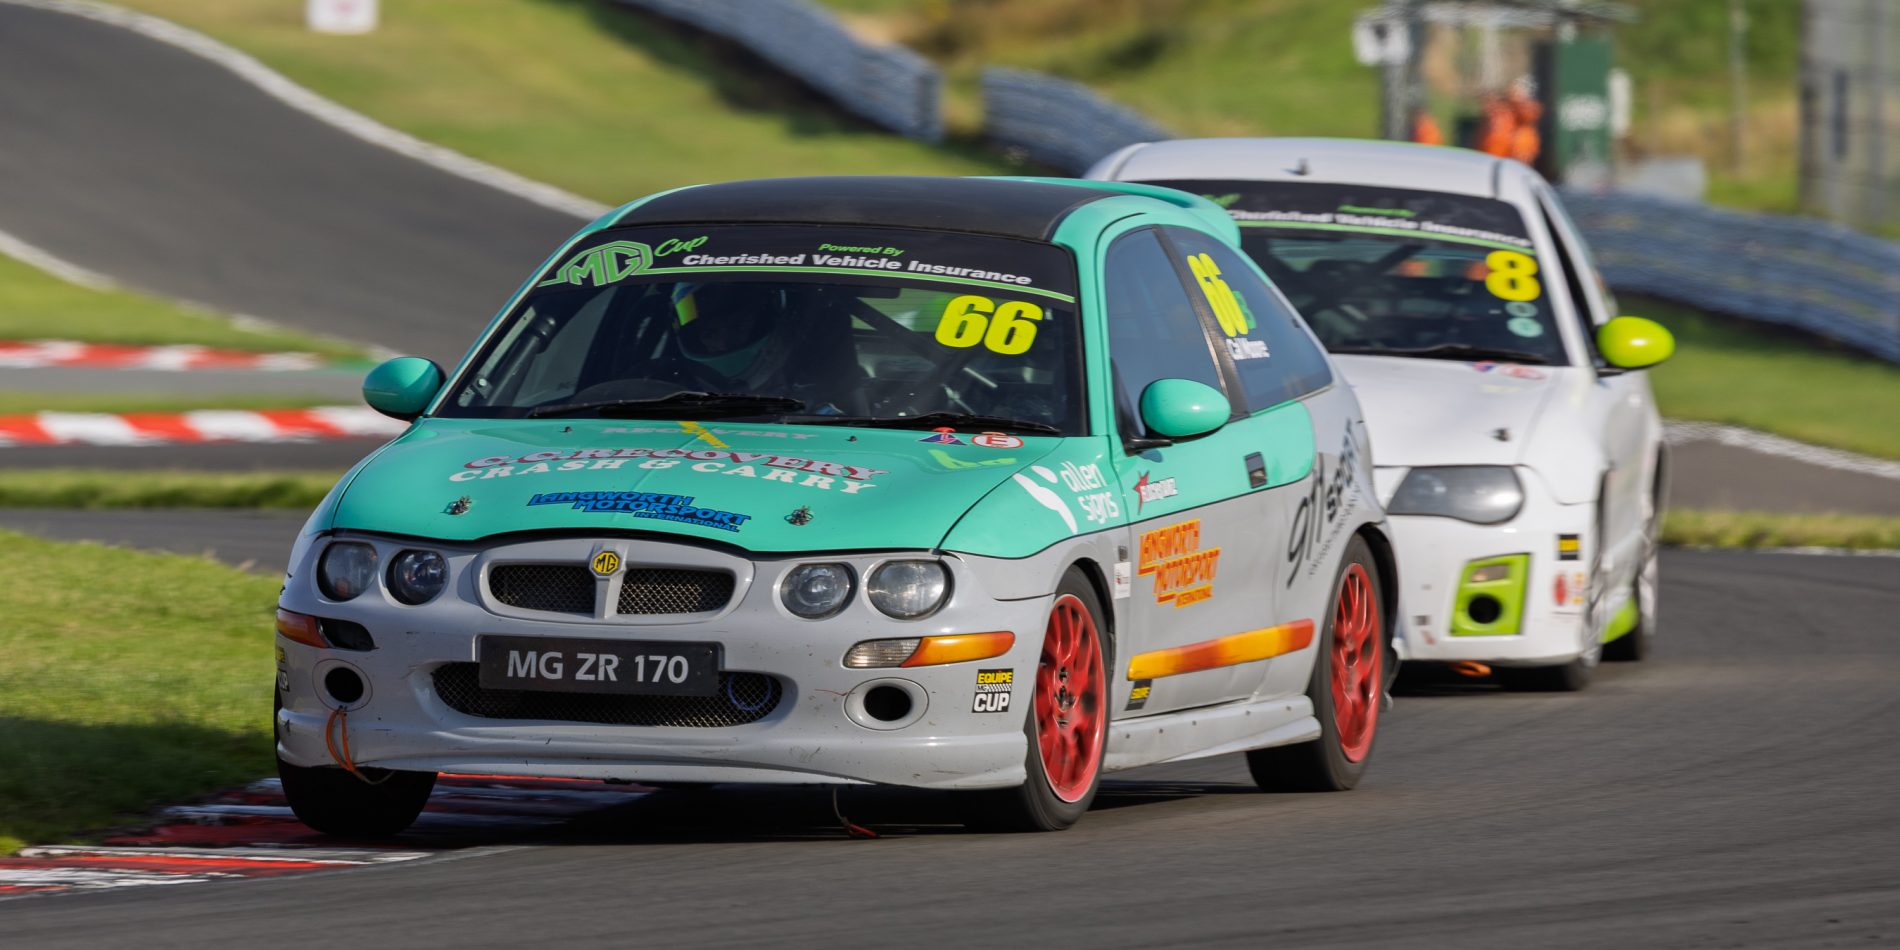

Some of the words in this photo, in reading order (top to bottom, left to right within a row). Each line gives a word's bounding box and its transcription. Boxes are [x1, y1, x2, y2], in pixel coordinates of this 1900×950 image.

[565, 244, 645, 287] MG
[654, 236, 709, 257] Cup
[818, 243, 881, 255] Powered
[883, 246, 904, 257] By
[682, 253, 805, 266] Cherished
[811, 254, 902, 270] Vehicle
[907, 260, 1032, 285] Insurance
[1485, 250, 1541, 302] 8
[934, 294, 1044, 355] 66
[449, 459, 629, 482] CRASH
[638, 459, 681, 470] &
[691, 462, 877, 494] CARRY
[1060, 460, 1108, 492] allen
[527, 491, 695, 506] LANGWORTH
[572, 499, 751, 526] MOTORSPORT
[1078, 491, 1119, 524] signs
[634, 511, 740, 533] INTERNATIONAL
[596, 554, 617, 572] MG
[507, 650, 563, 680] MG
[575, 653, 620, 682] ZR
[635, 654, 689, 684] 170
[978, 672, 1013, 684] EQUIPE
[974, 693, 1010, 711] CUP
